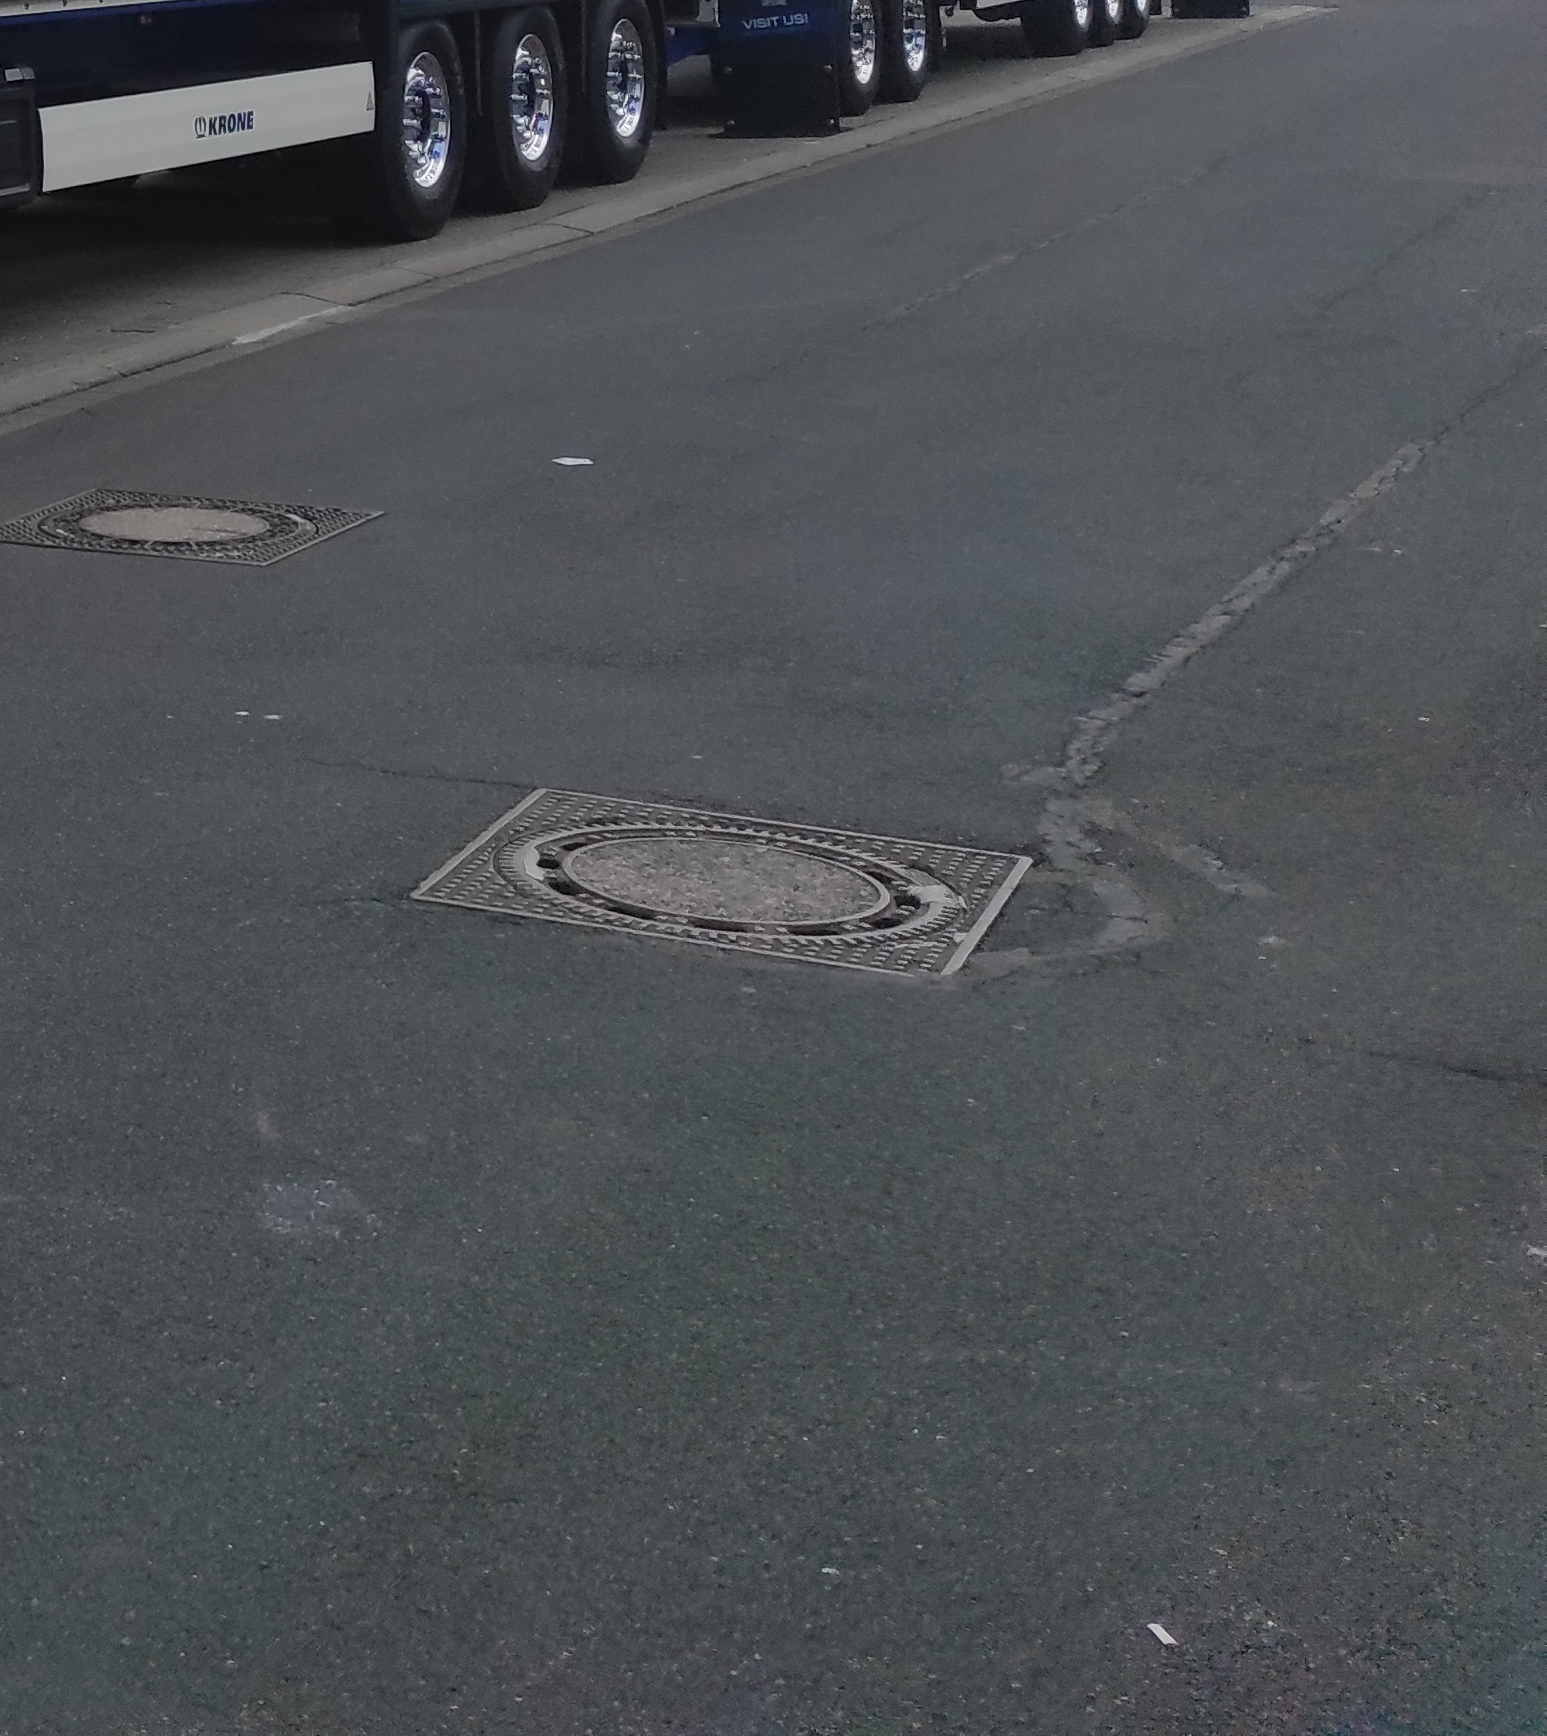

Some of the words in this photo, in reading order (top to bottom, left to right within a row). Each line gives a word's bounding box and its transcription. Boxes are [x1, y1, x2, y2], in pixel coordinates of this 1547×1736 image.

[743, 16, 779, 30] VISIT
[783, 13, 809, 27] US!
[208, 110, 255, 137] KRONE
